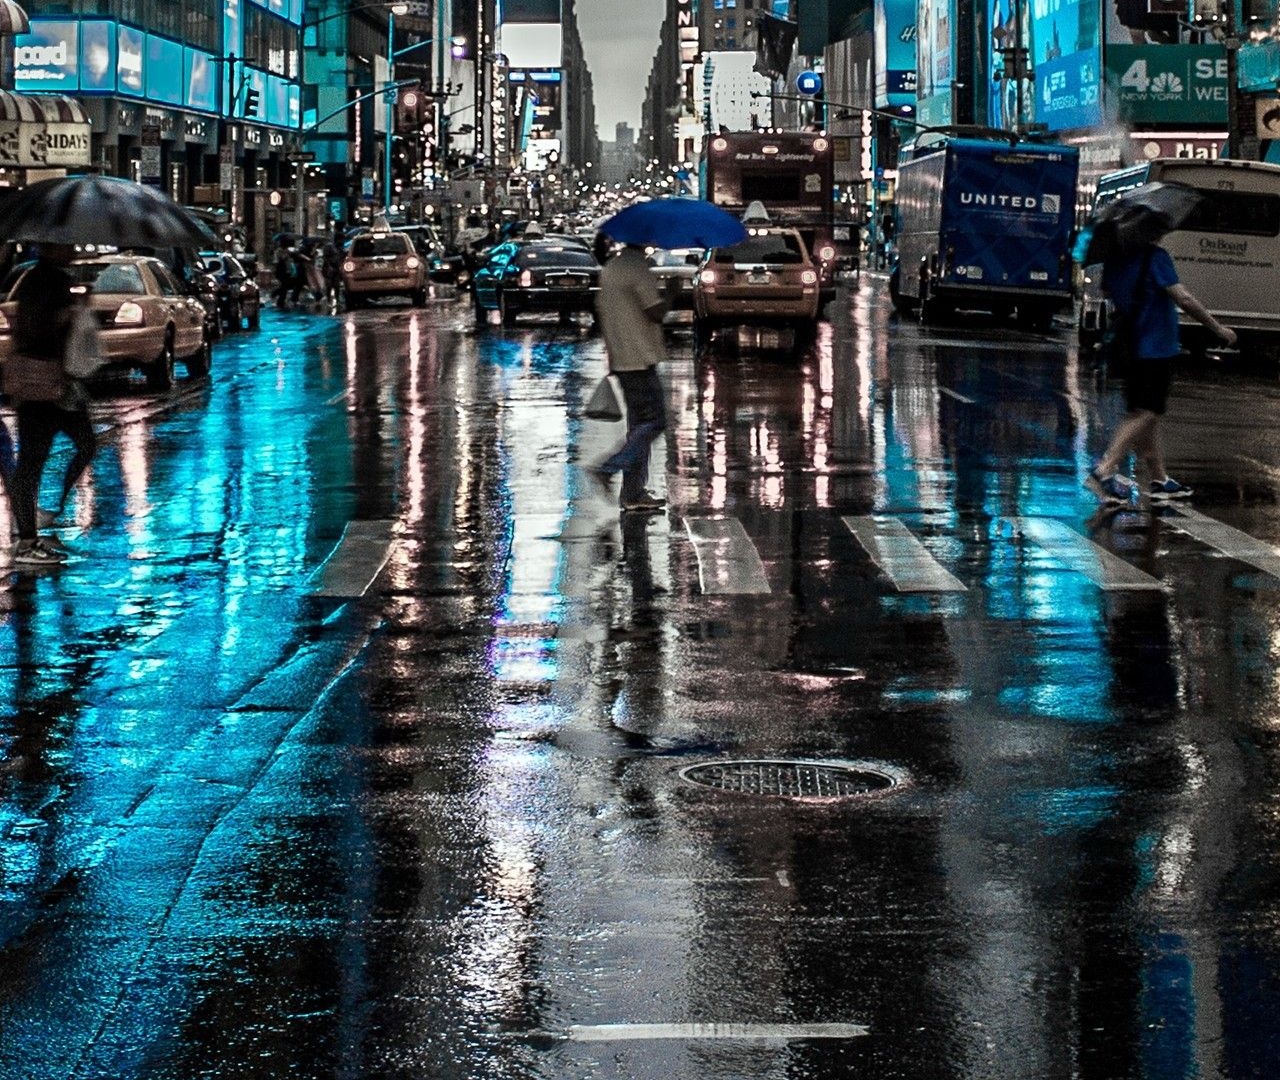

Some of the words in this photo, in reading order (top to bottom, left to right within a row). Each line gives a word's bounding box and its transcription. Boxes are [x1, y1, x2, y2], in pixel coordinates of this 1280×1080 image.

[404, 0, 431, 17] OPEZ
[1120, 58, 1151, 93] 4
[1121, 93, 1148, 101] NEW
[1150, 93, 1183, 101] YORK
[1195, 86, 1228, 101] WE
[45, 133, 89, 150] RIDAY'S
[960, 191, 1037, 209] UNITED
